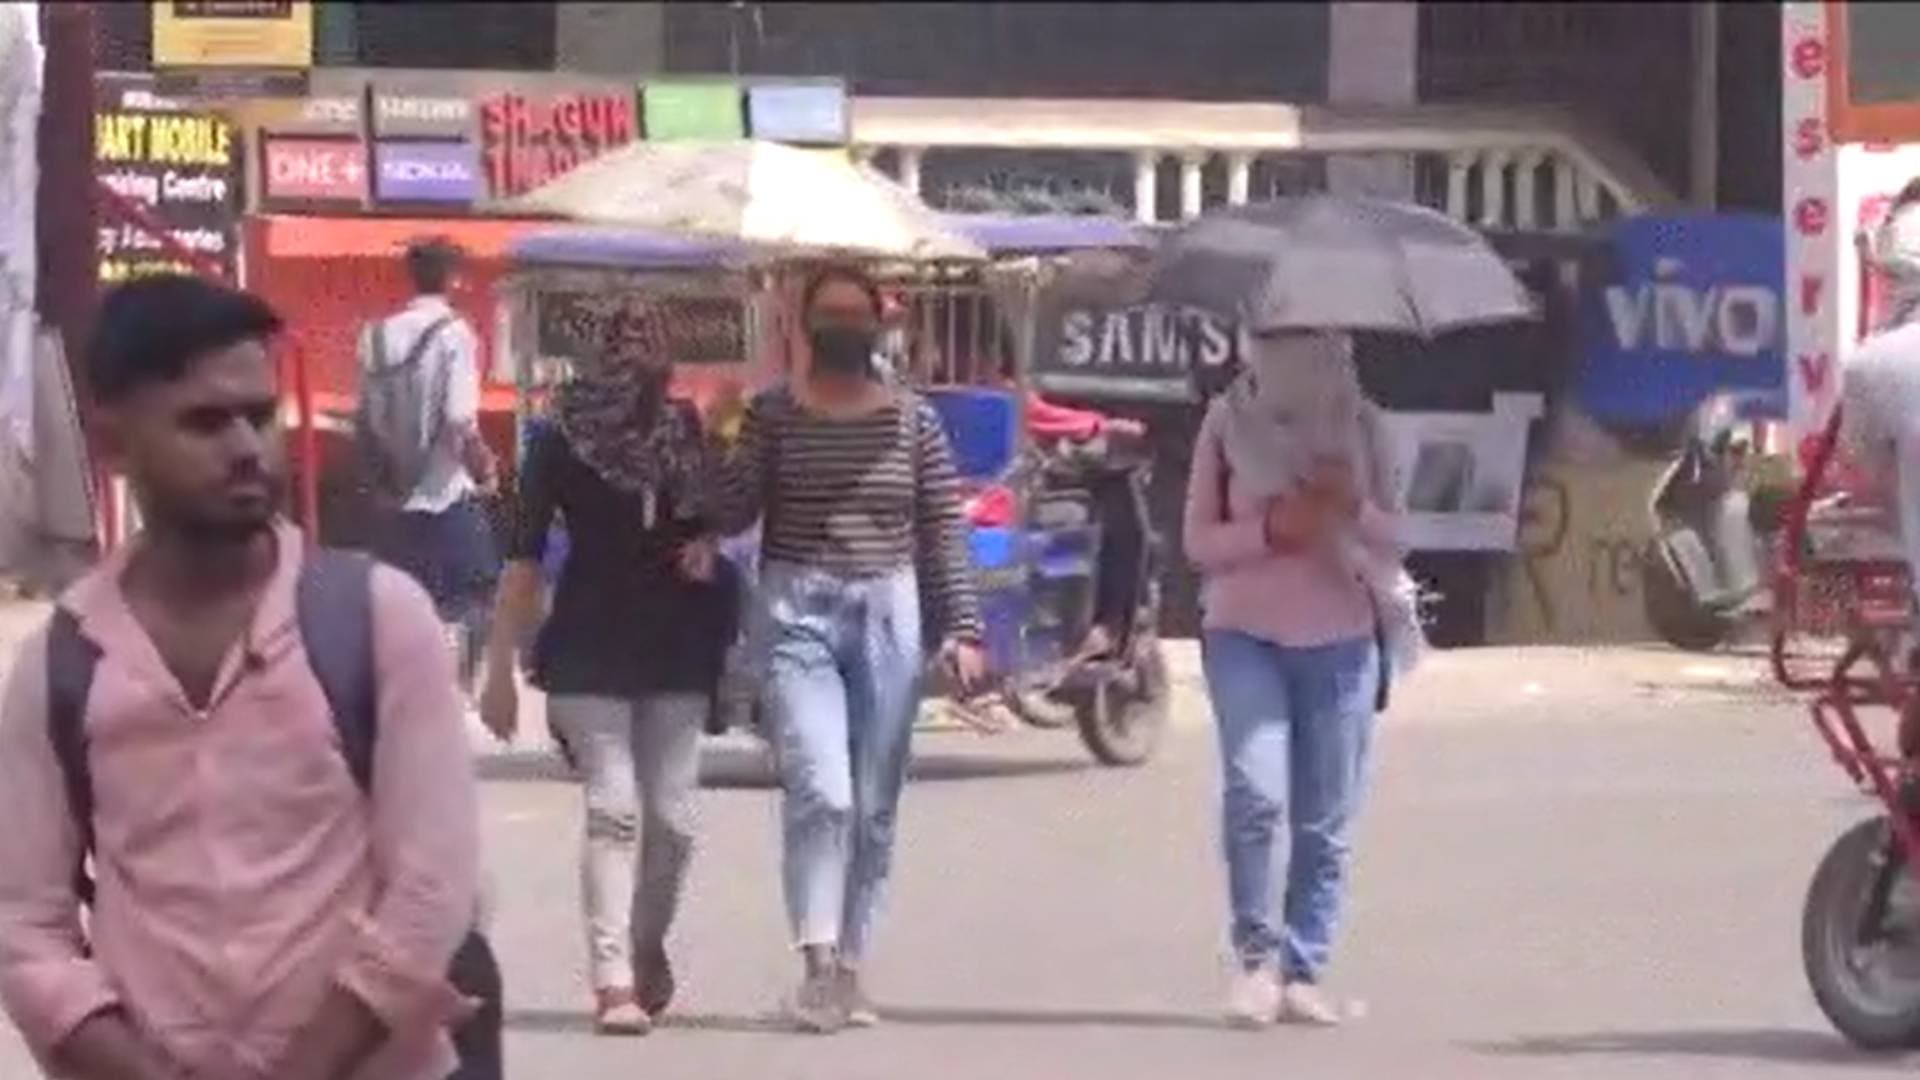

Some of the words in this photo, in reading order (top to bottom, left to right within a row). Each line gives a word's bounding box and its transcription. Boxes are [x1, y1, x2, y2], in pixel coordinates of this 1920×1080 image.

[149, 116, 230, 166] MOBILE
[162, 170, 227, 201] Centre
[1605, 257, 1778, 356] vivo
